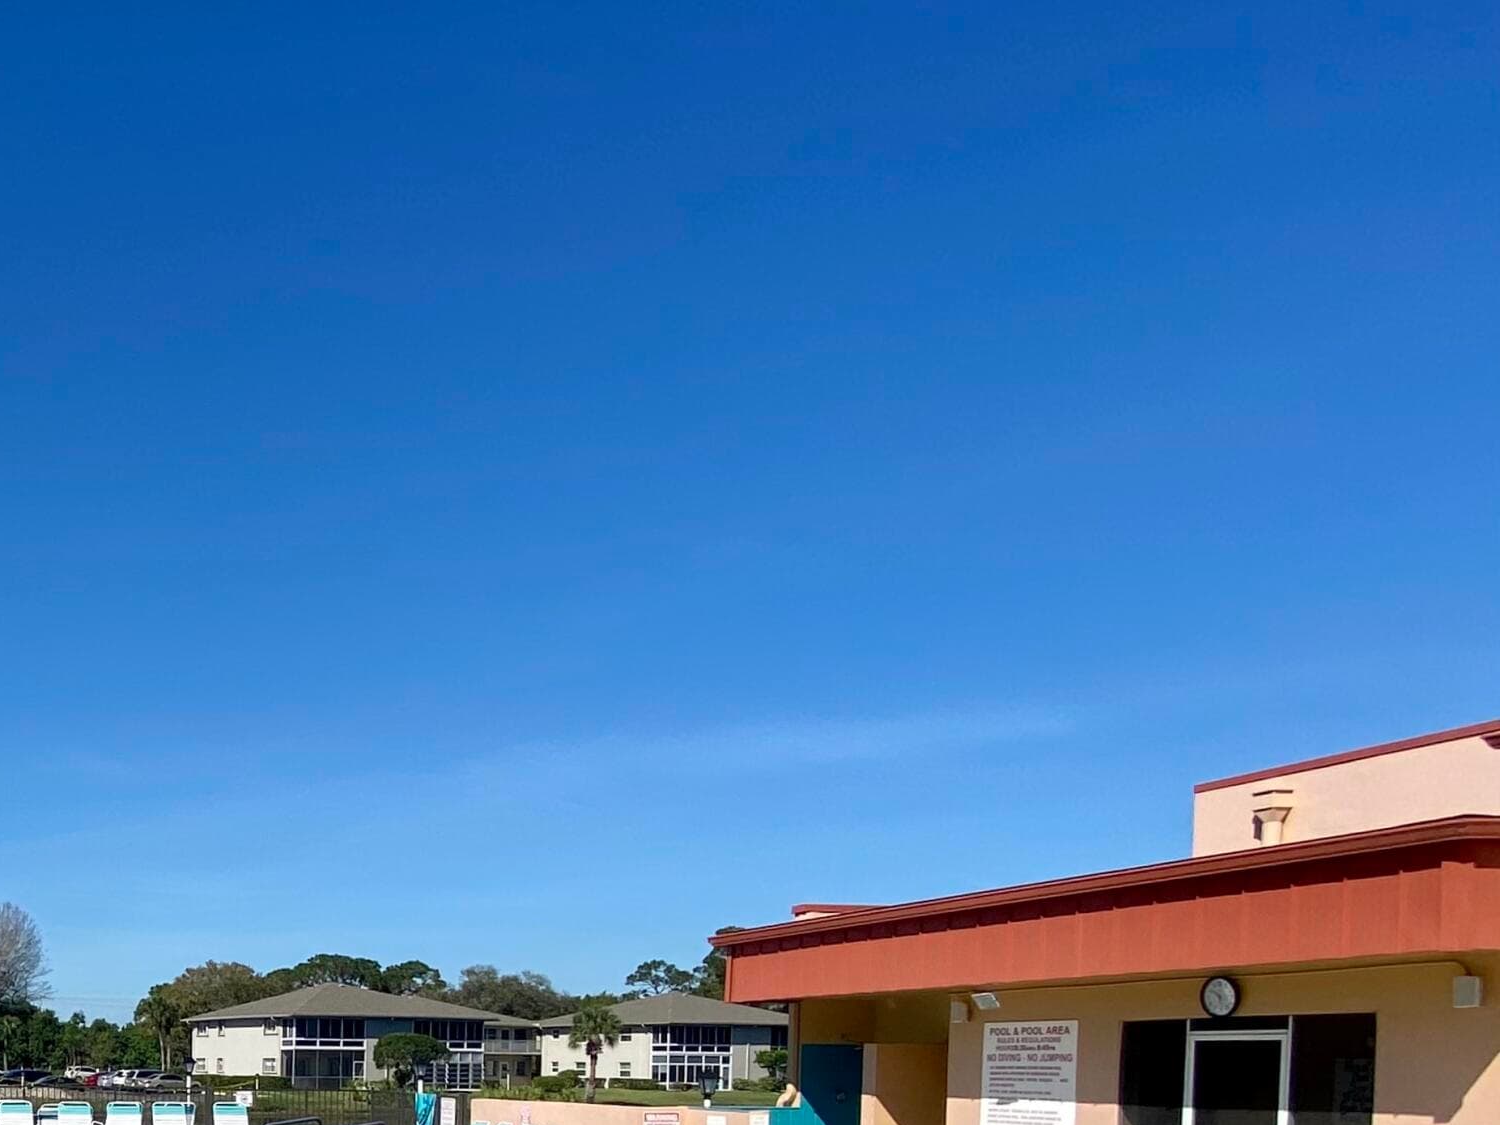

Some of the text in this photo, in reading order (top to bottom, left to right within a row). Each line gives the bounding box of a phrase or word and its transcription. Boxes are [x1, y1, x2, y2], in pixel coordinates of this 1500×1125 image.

[990, 1027, 1011, 1036] POOL
[1021, 1026, 1043, 1035] POOL
[1046, 1026, 1070, 1035] AREA
[987, 1054, 996, 1062] NO
[998, 1053, 1021, 1062] DIVING
[1027, 1054, 1038, 1062] NO
[1040, 1053, 1073, 1062] JUMPING
